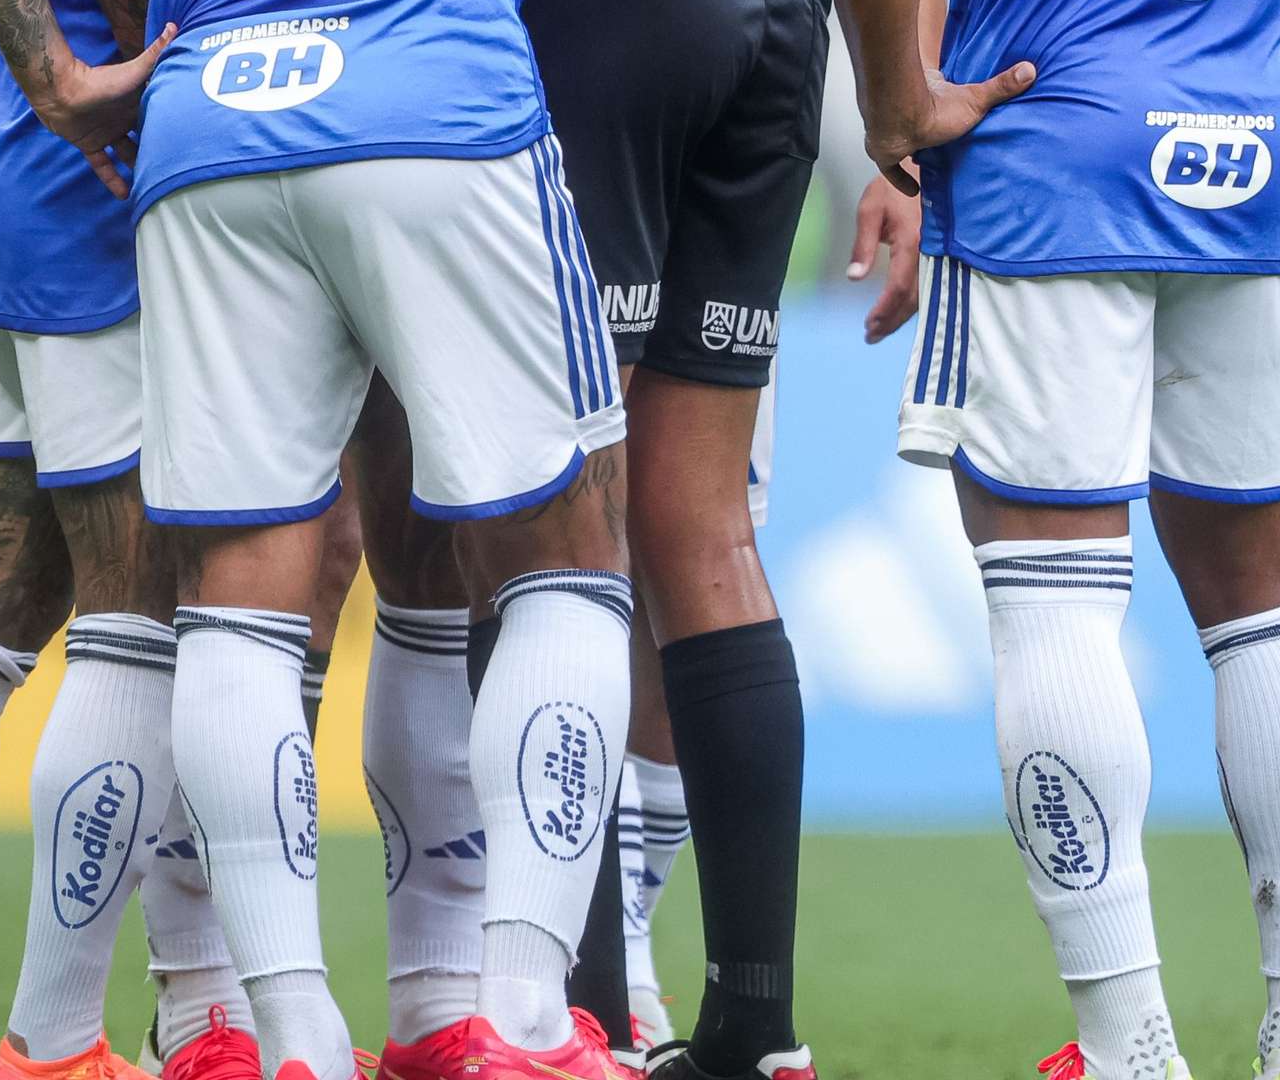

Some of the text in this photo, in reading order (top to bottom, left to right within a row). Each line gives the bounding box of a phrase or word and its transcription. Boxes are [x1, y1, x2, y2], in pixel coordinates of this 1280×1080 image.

[199, 16, 350, 52] SUPERMERCADOS
[217, 43, 326, 96] BH
[1145, 111, 1276, 132] SUPERMERCADOS
[1163, 141, 1259, 189] BH
[541, 713, 587, 846] Kodilar
[61, 774, 127, 906] Kodilar
[1031, 764, 1095, 876] Kodilar
